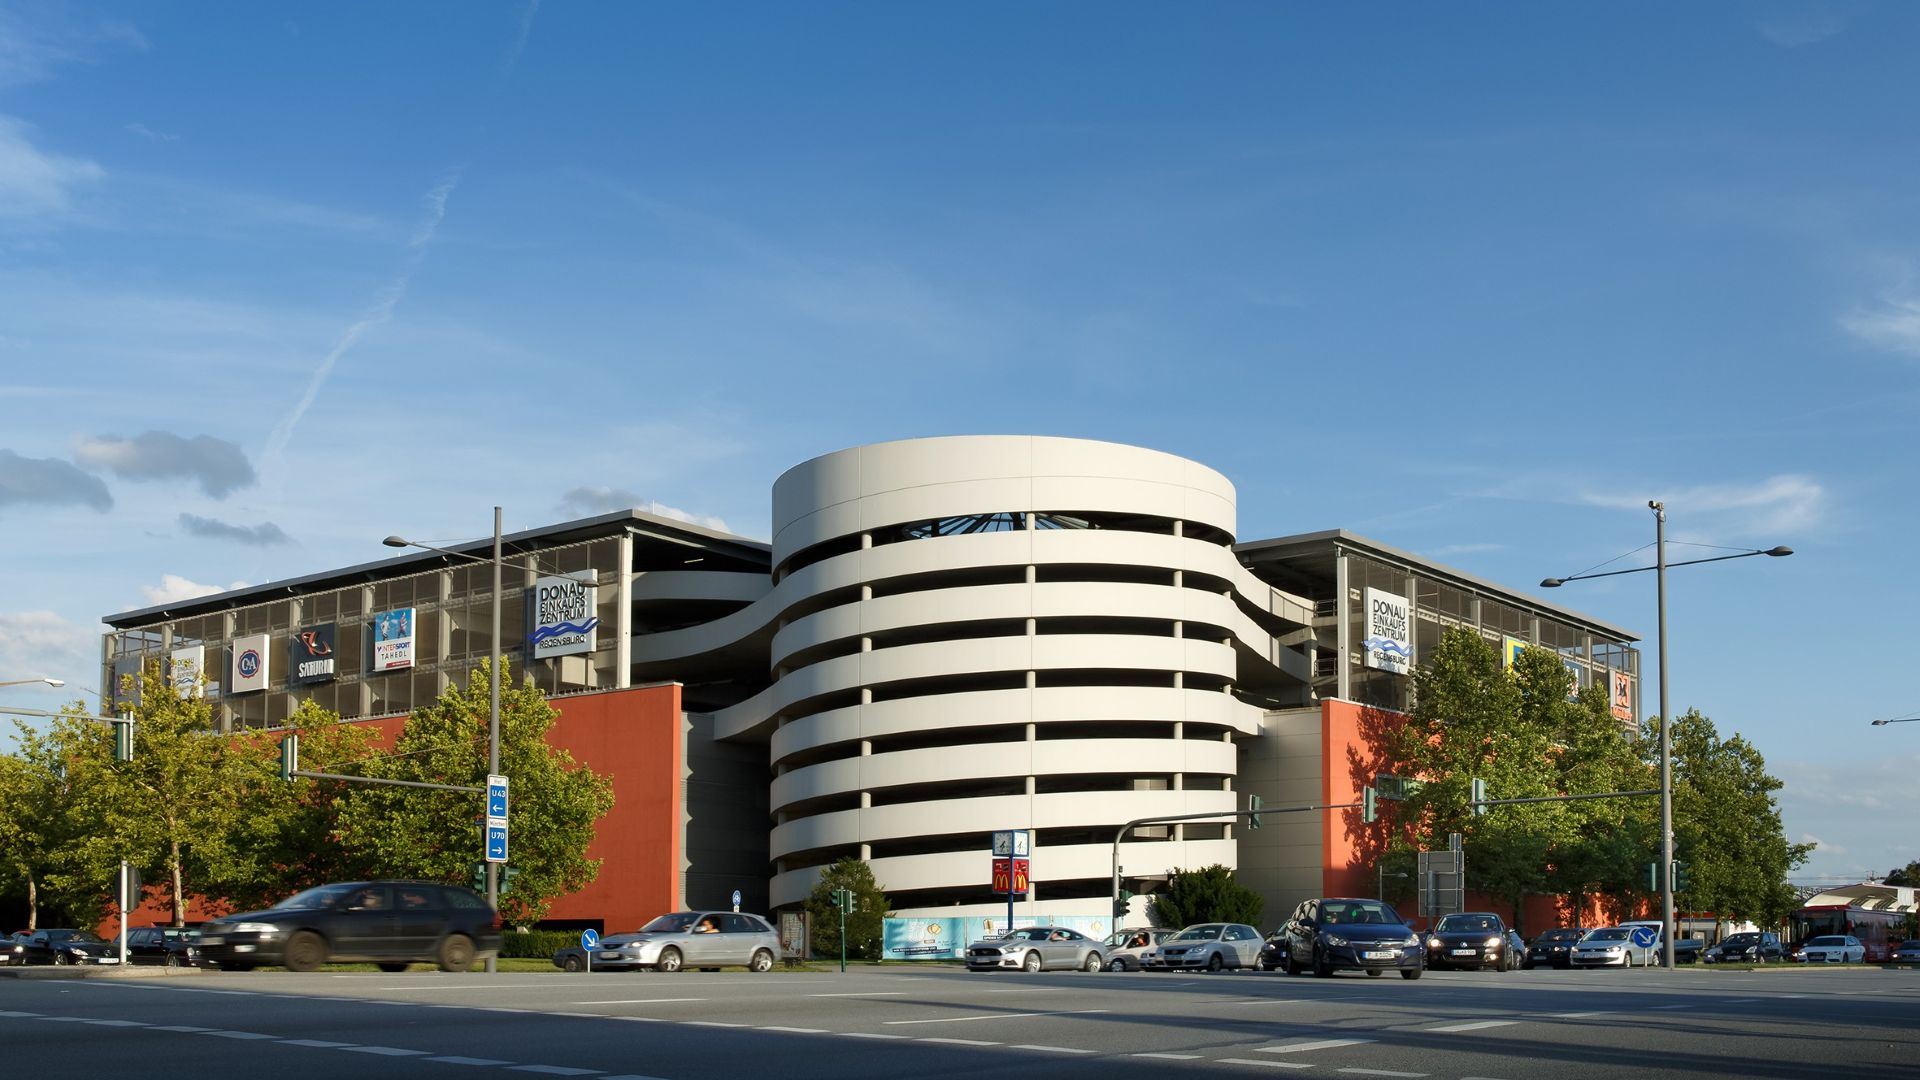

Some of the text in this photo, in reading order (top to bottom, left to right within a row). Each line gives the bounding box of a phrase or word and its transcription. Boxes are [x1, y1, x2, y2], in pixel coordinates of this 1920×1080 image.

[541, 582, 586, 601] DONAU
[540, 596, 586, 613] EINKAUFS
[1373, 599, 1406, 620] DONAU
[540, 608, 586, 624] ZENTRUM
[1373, 613, 1406, 631] EINKAUFS
[1373, 624, 1406, 642] ZENTRUM
[540, 635, 586, 649] REGENSBURG
[241, 657, 257, 671] C&A
[1373, 650, 1407, 665] REGENSBURG
[298, 658, 334, 678] SATURN
